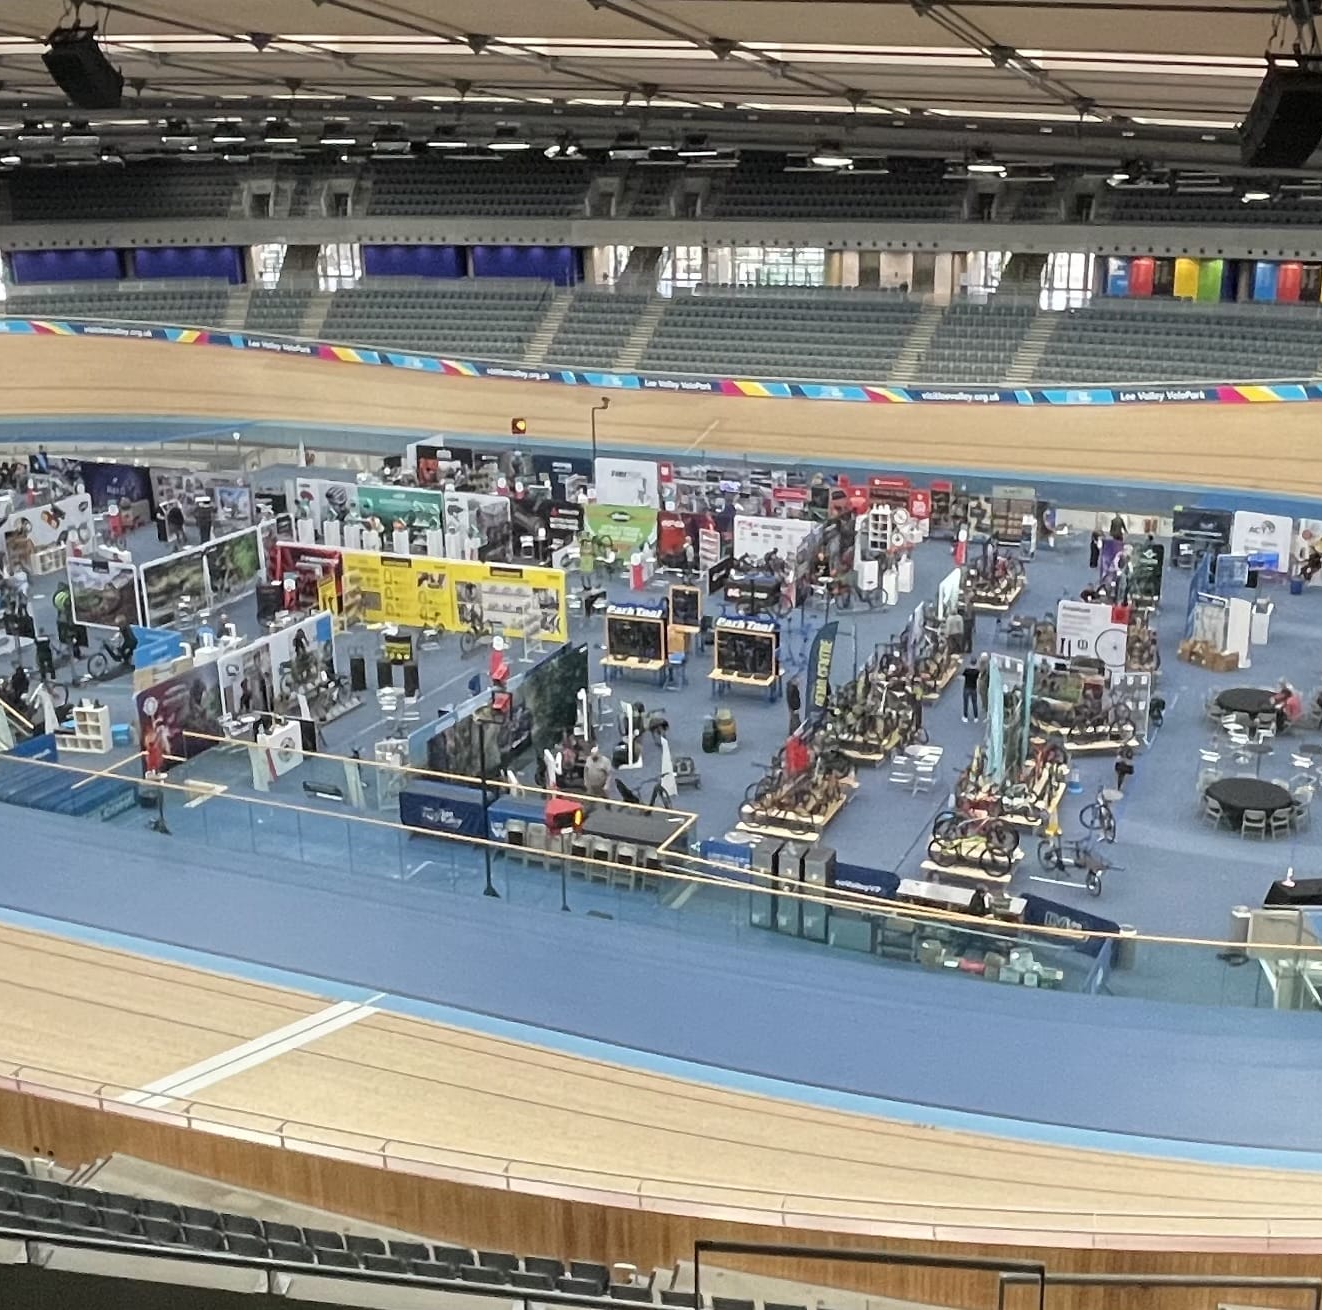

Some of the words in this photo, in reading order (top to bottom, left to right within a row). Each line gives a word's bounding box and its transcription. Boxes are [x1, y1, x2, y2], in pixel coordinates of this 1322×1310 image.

[644, 379, 657, 388] Lee
[1120, 391, 1136, 401] Lee
[1138, 391, 1164, 402] Valley
[1166, 390, 1206, 401] VeloPark
